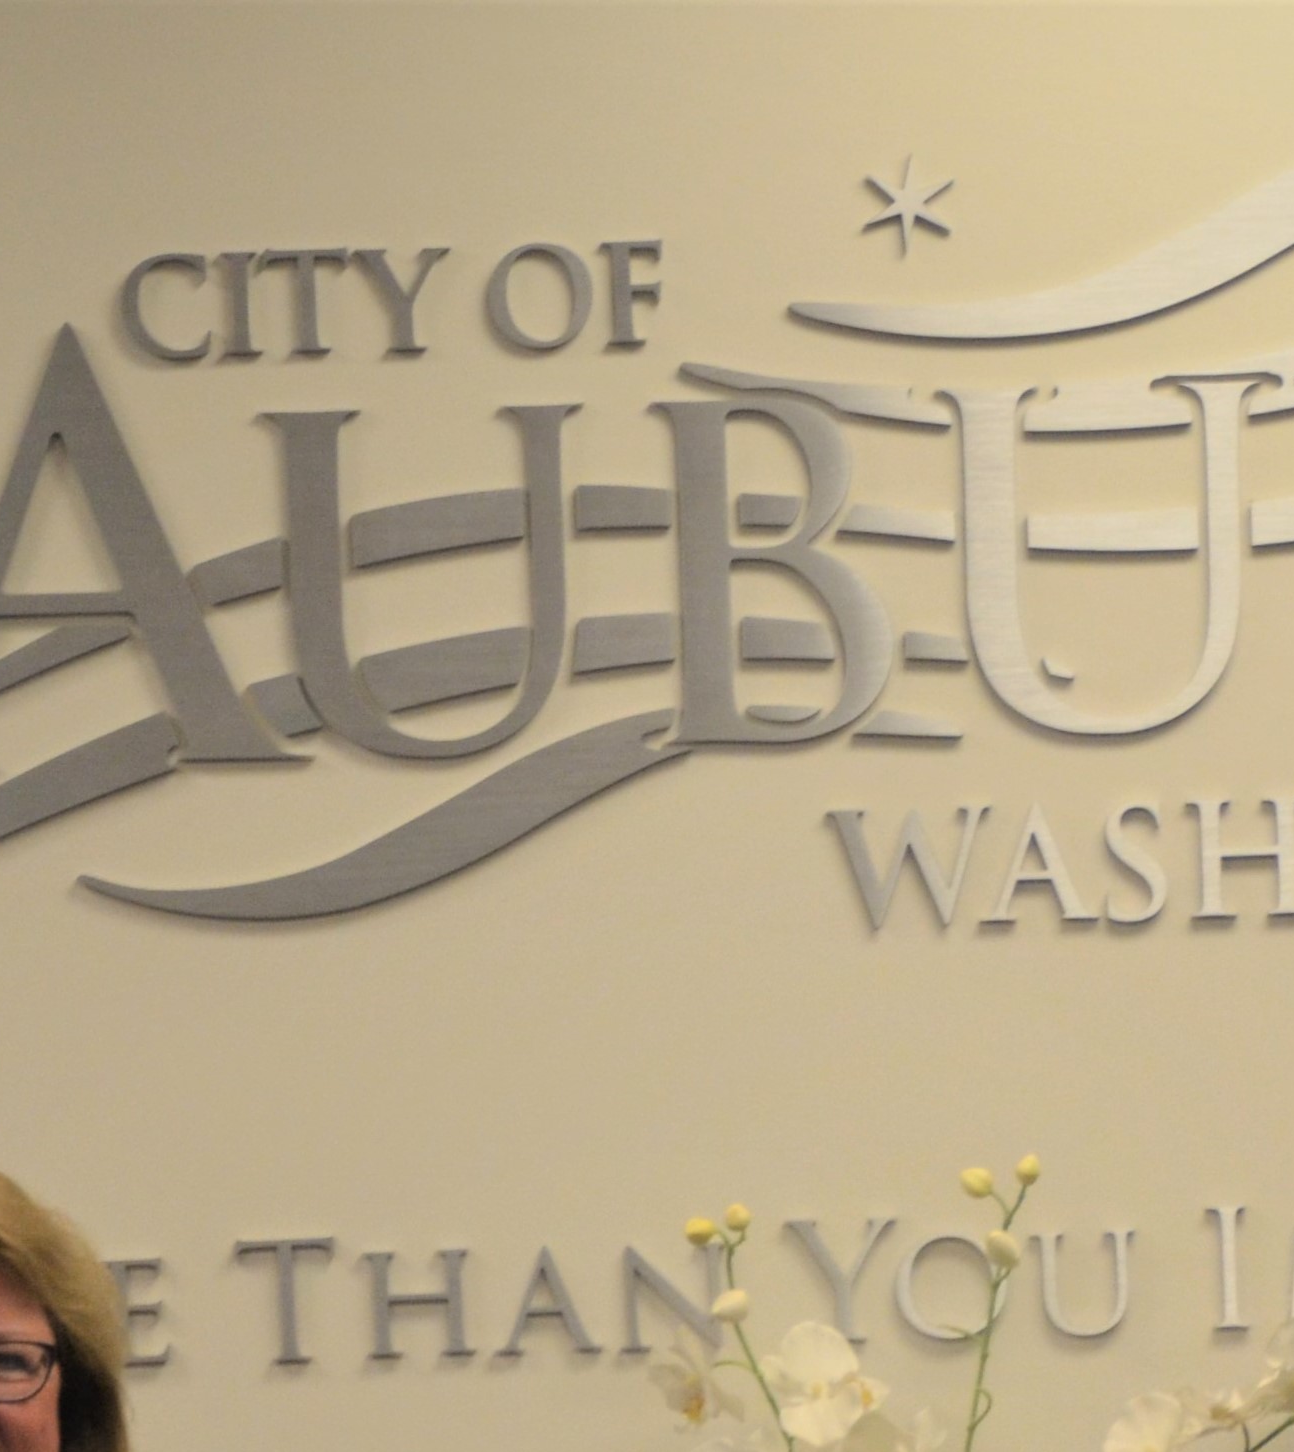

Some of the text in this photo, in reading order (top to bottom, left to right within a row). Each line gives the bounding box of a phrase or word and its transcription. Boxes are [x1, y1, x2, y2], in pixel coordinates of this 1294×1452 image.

[119, 239, 662, 363] CITY OF
[233, 1237, 724, 1366] THAN
[782, 1216, 1135, 1345] YOU
